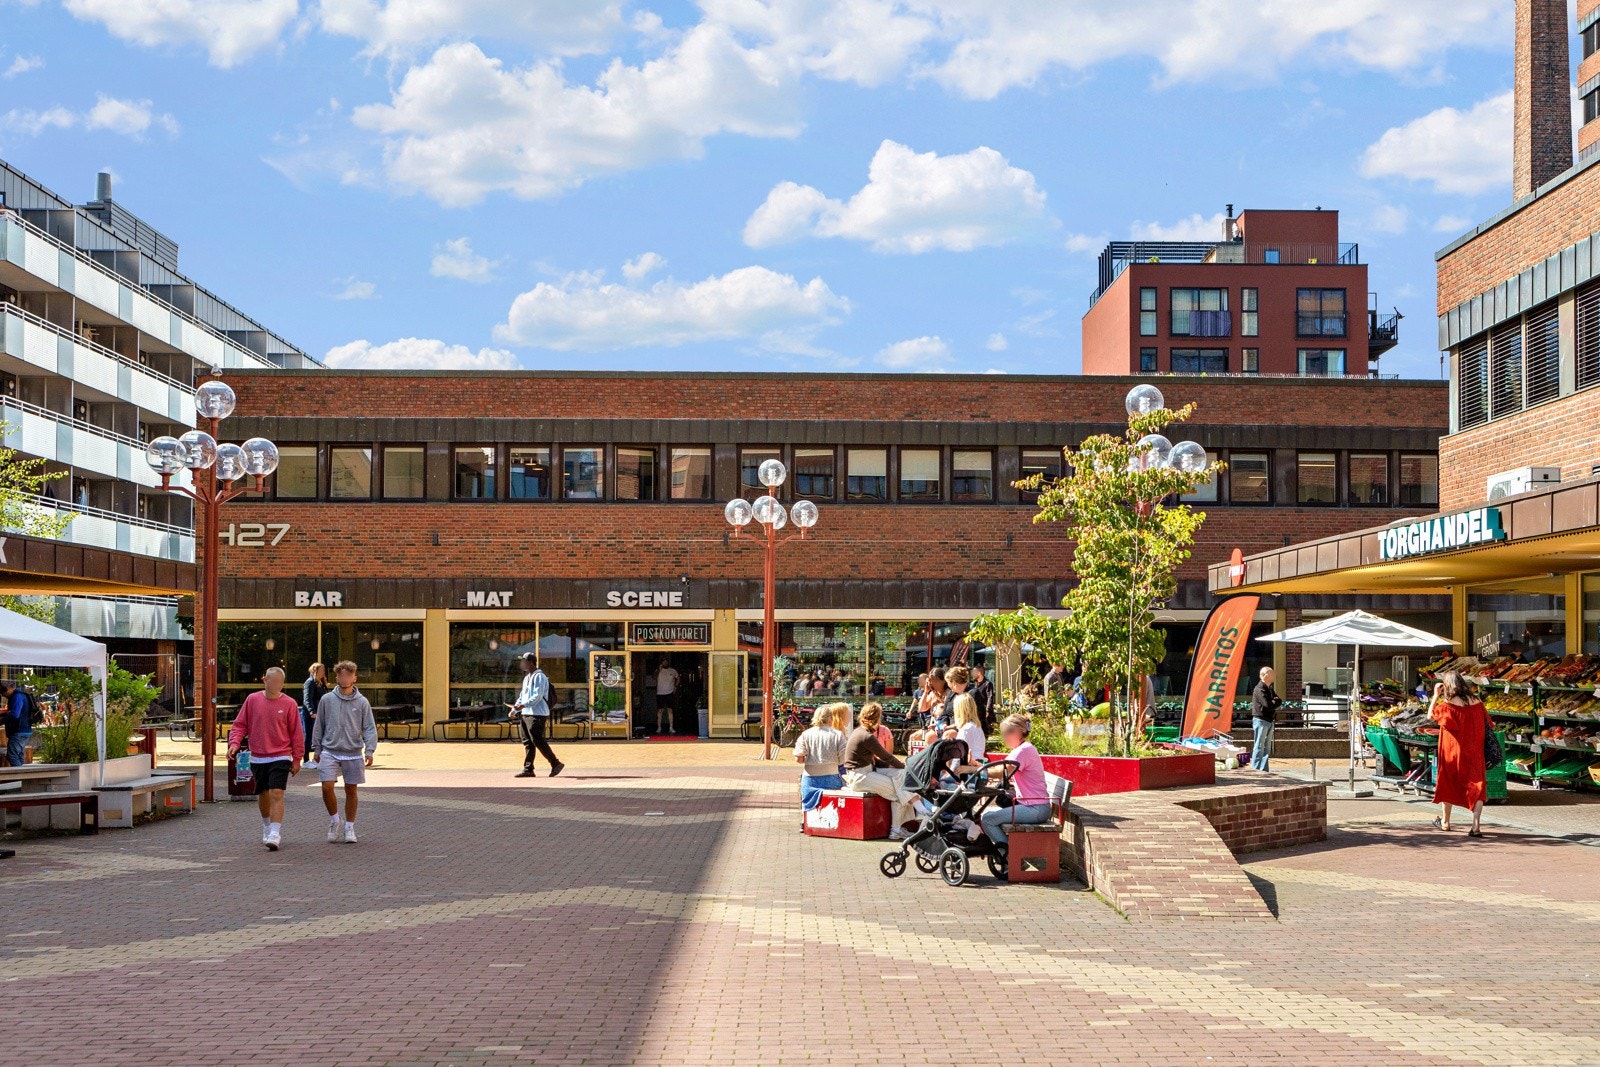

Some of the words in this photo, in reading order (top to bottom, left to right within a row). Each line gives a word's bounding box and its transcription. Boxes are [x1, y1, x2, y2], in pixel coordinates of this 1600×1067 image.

[1378, 507, 1494, 560] TORGHANDEL
[295, 590, 342, 607] BAR
[466, 591, 513, 607] MAT
[606, 591, 683, 607] SCENE
[637, 627, 705, 640] POSTKONTORET
[1204, 626, 1239, 720] JARRITOS
